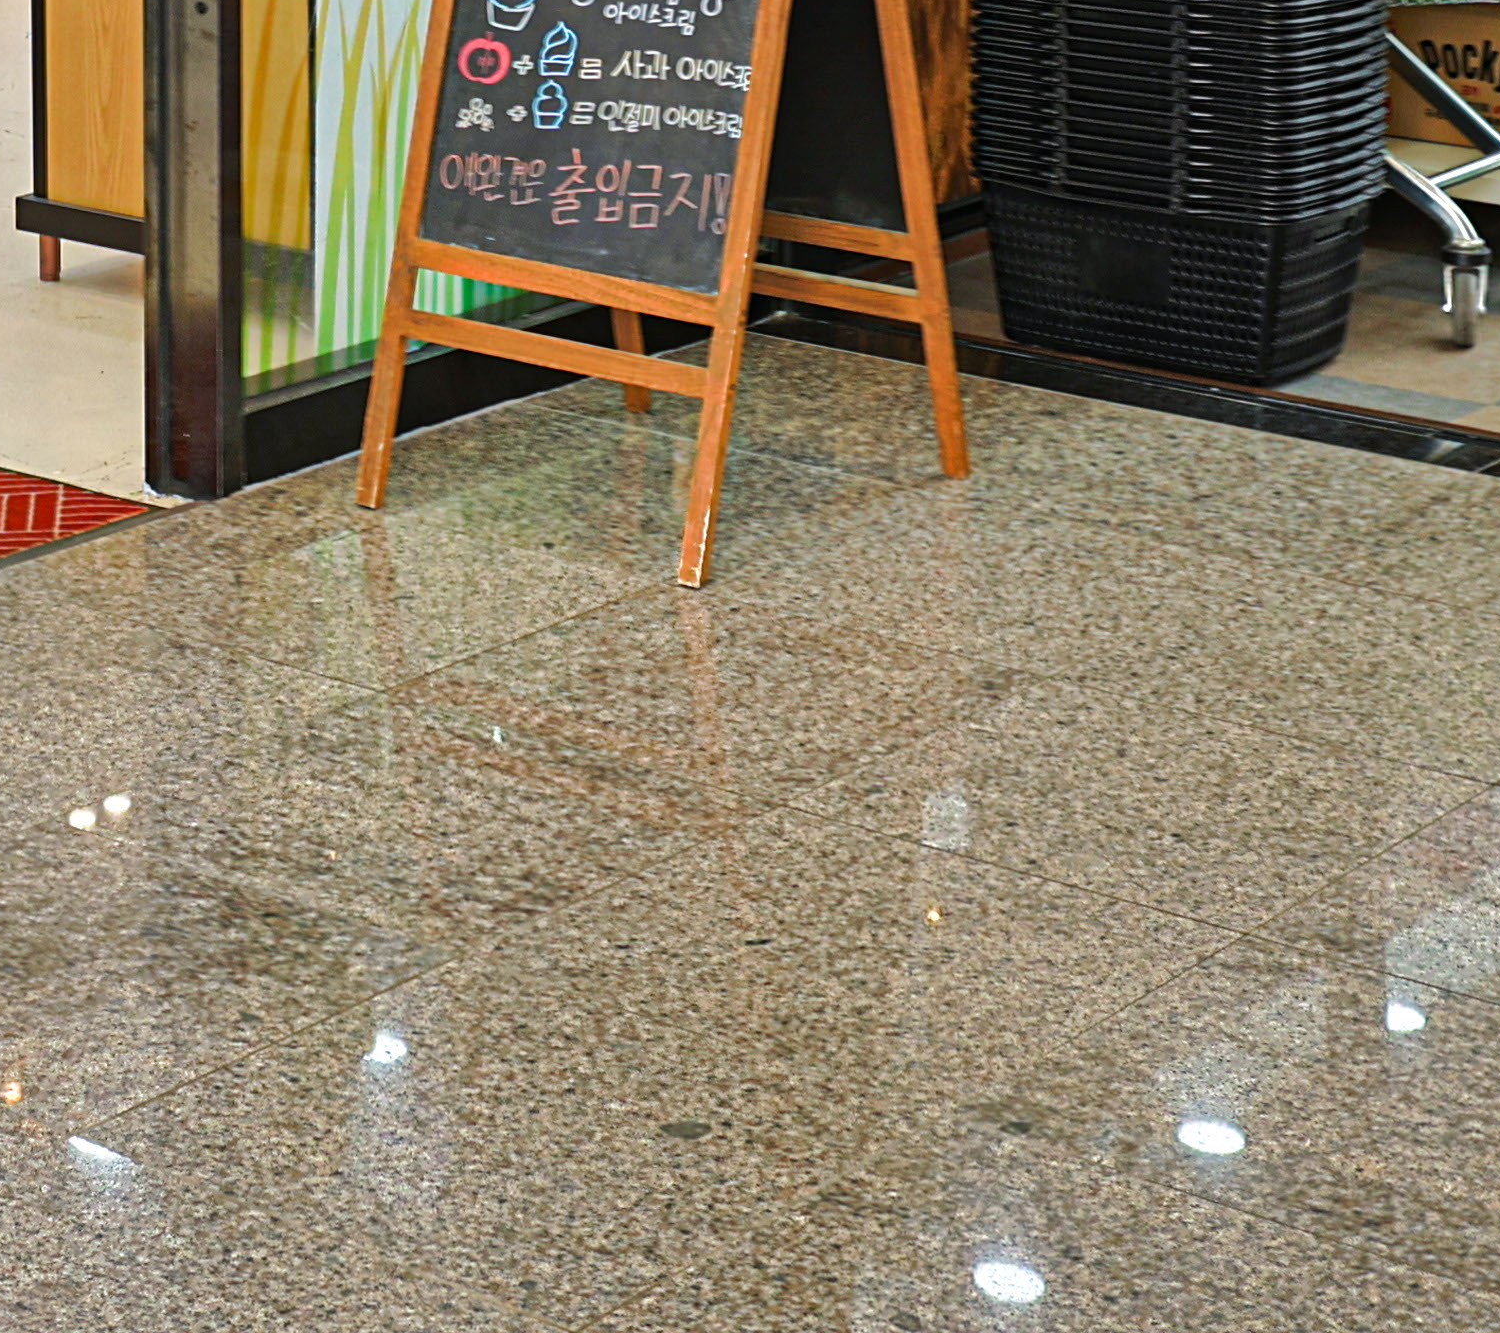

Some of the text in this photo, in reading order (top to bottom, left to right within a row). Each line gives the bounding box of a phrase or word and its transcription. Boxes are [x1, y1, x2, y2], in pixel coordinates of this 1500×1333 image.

[602, 1, 697, 36] 아이스크림
[610, 49, 671, 80] 사과
[597, 99, 661, 133] 인절미
